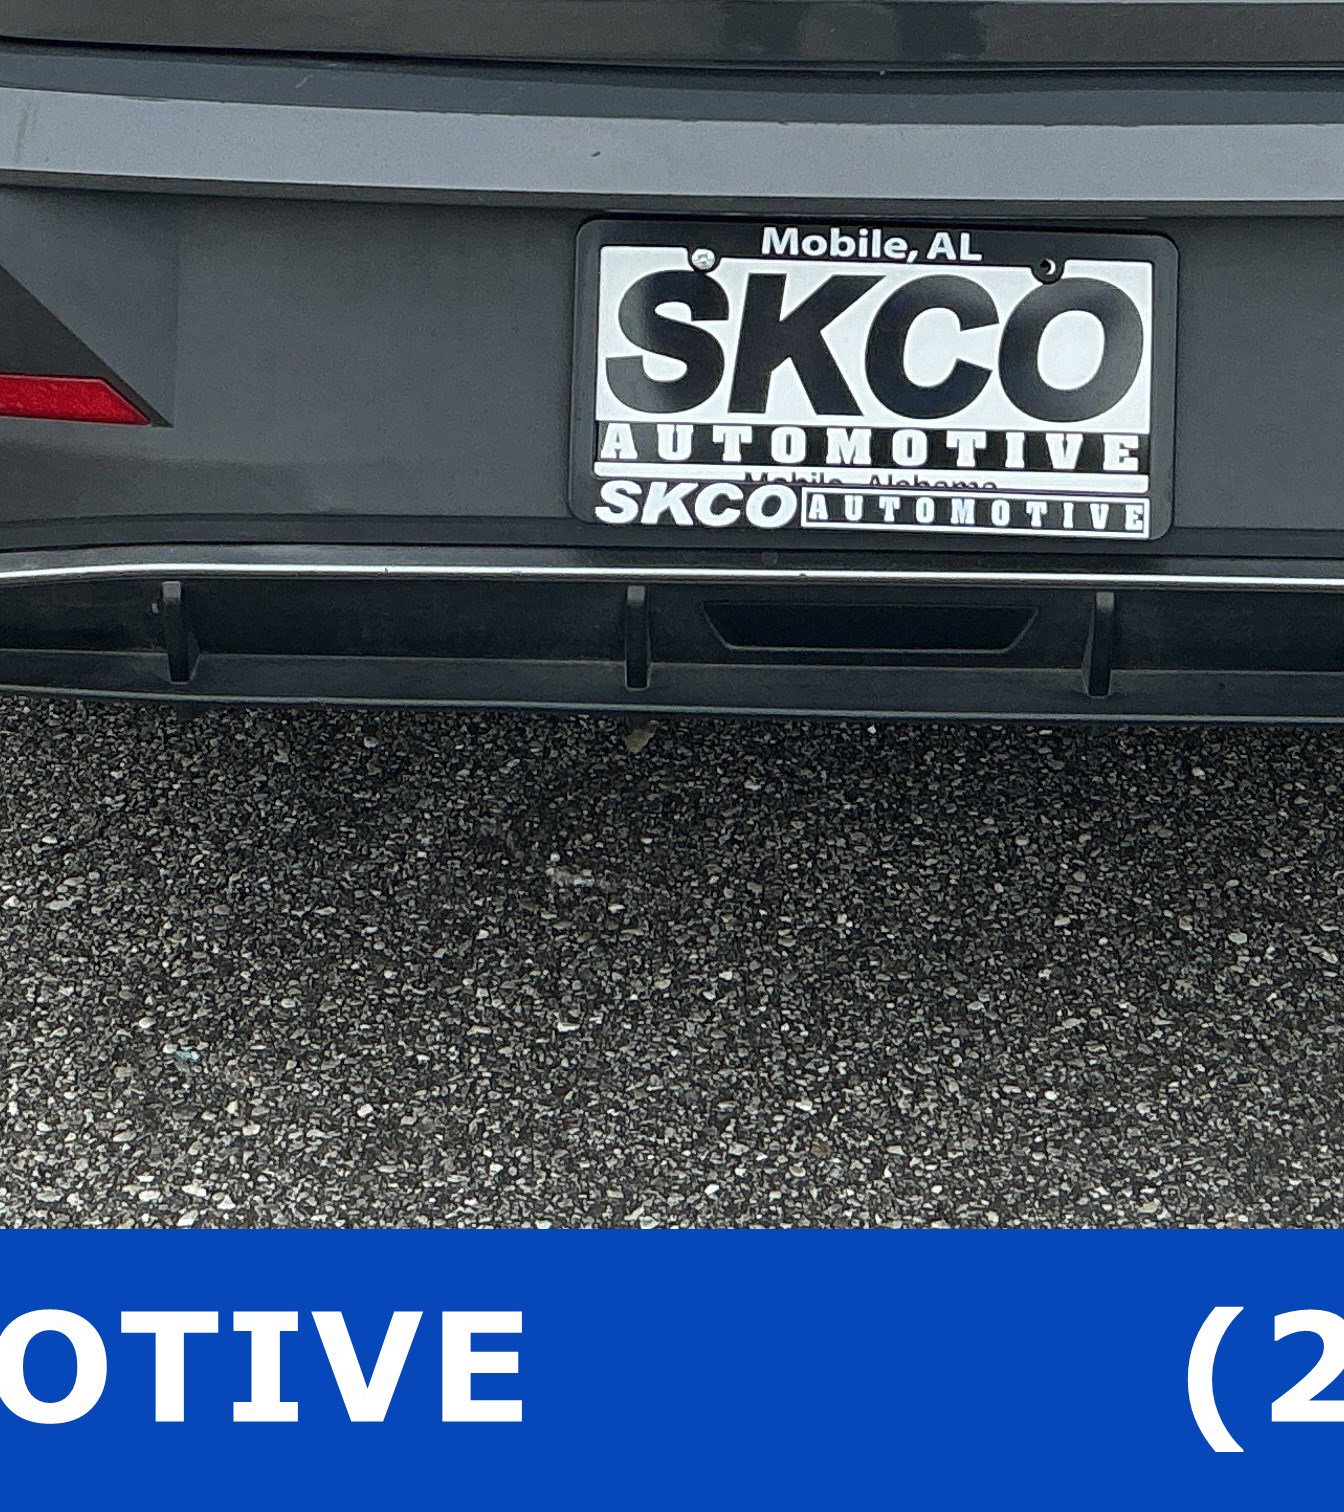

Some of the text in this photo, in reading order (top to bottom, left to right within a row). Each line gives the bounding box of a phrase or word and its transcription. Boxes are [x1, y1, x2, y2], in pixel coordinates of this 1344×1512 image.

[761, 226, 983, 264] Mobile, AL
[605, 269, 1145, 423] SKCO
[601, 424, 1141, 472] AUTOMOTIVE
[595, 480, 1144, 532] SKCO AUTOMOTIVE
